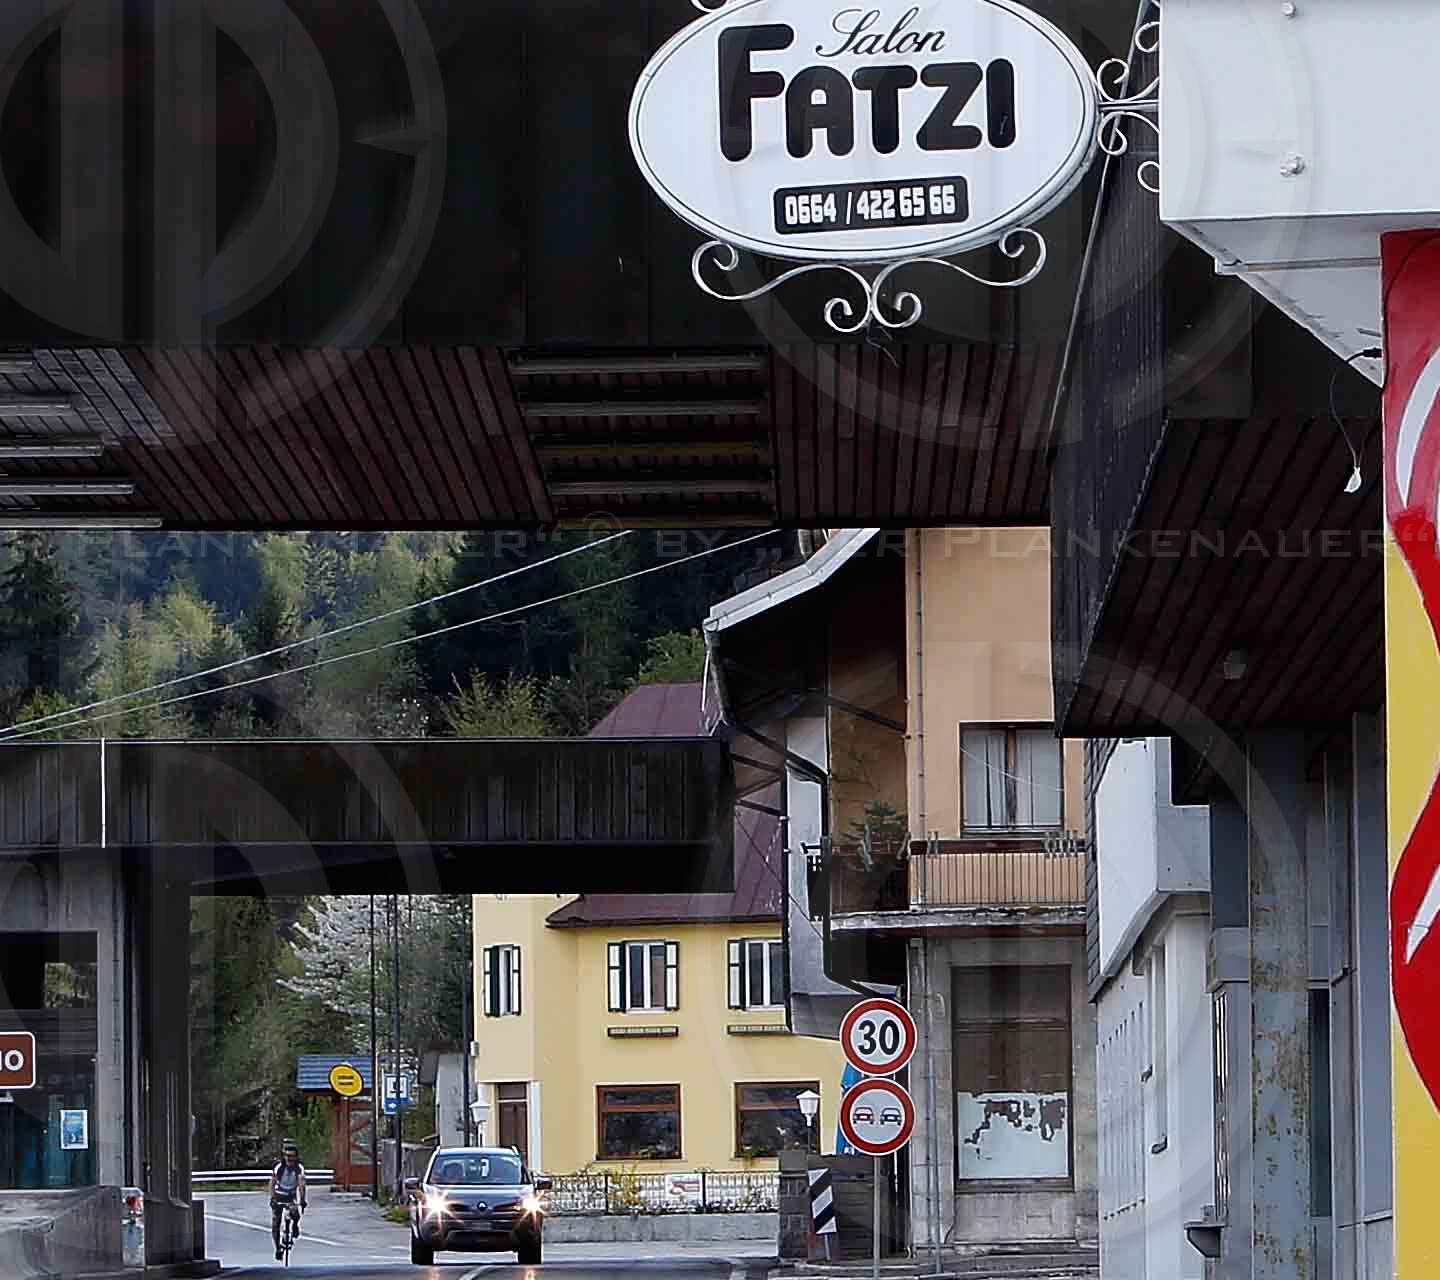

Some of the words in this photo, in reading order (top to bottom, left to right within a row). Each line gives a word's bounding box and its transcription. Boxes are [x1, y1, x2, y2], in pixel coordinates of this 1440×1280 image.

[816, 7, 946, 57] Salon
[718, 23, 1016, 162] FATZI
[785, 193, 837, 225] 0664
[899, 187, 925, 217] 65
[929, 184, 956, 215] 66
[858, 1019, 900, 1055] 30
